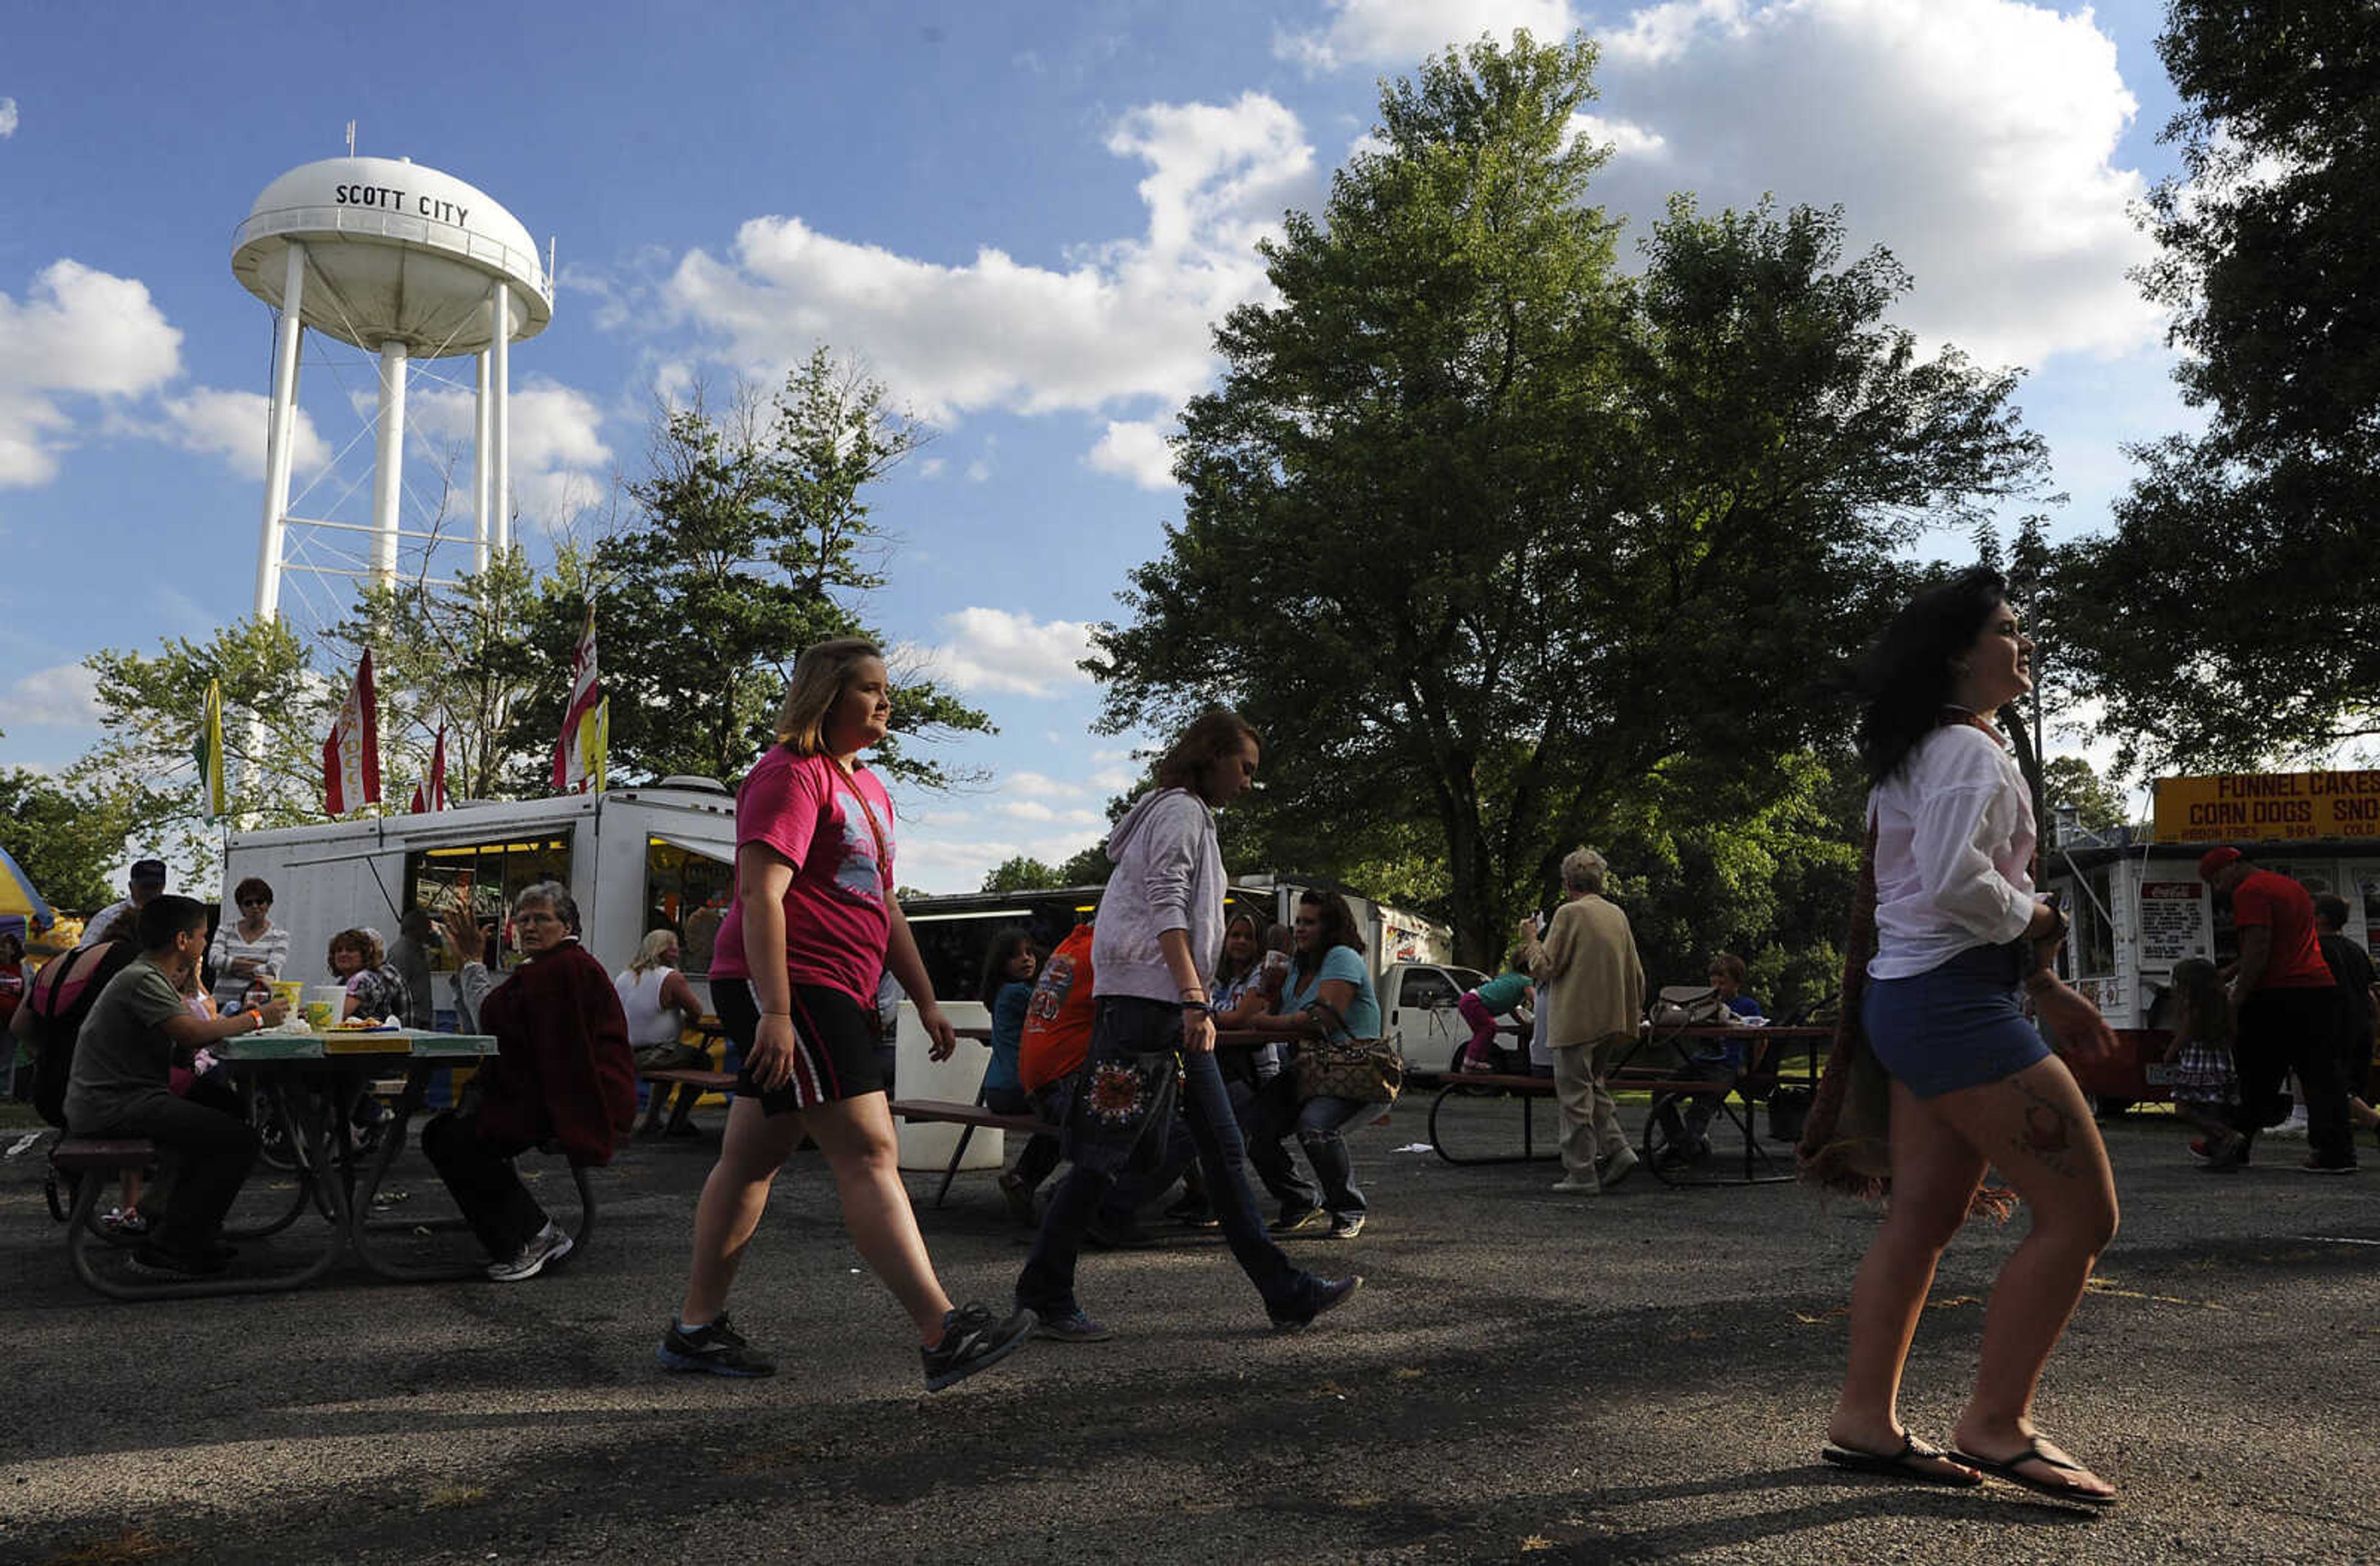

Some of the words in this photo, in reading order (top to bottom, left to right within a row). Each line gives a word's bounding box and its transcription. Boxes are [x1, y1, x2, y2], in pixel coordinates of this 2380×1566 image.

[336, 185, 405, 210] SCOTT
[420, 196, 469, 227] CITY
[2219, 774, 2303, 798] FUNNEL
[2310, 771, 2380, 795] CAKES
[2190, 802, 2246, 825] CORN
[2254, 800, 2311, 823] DOGS
